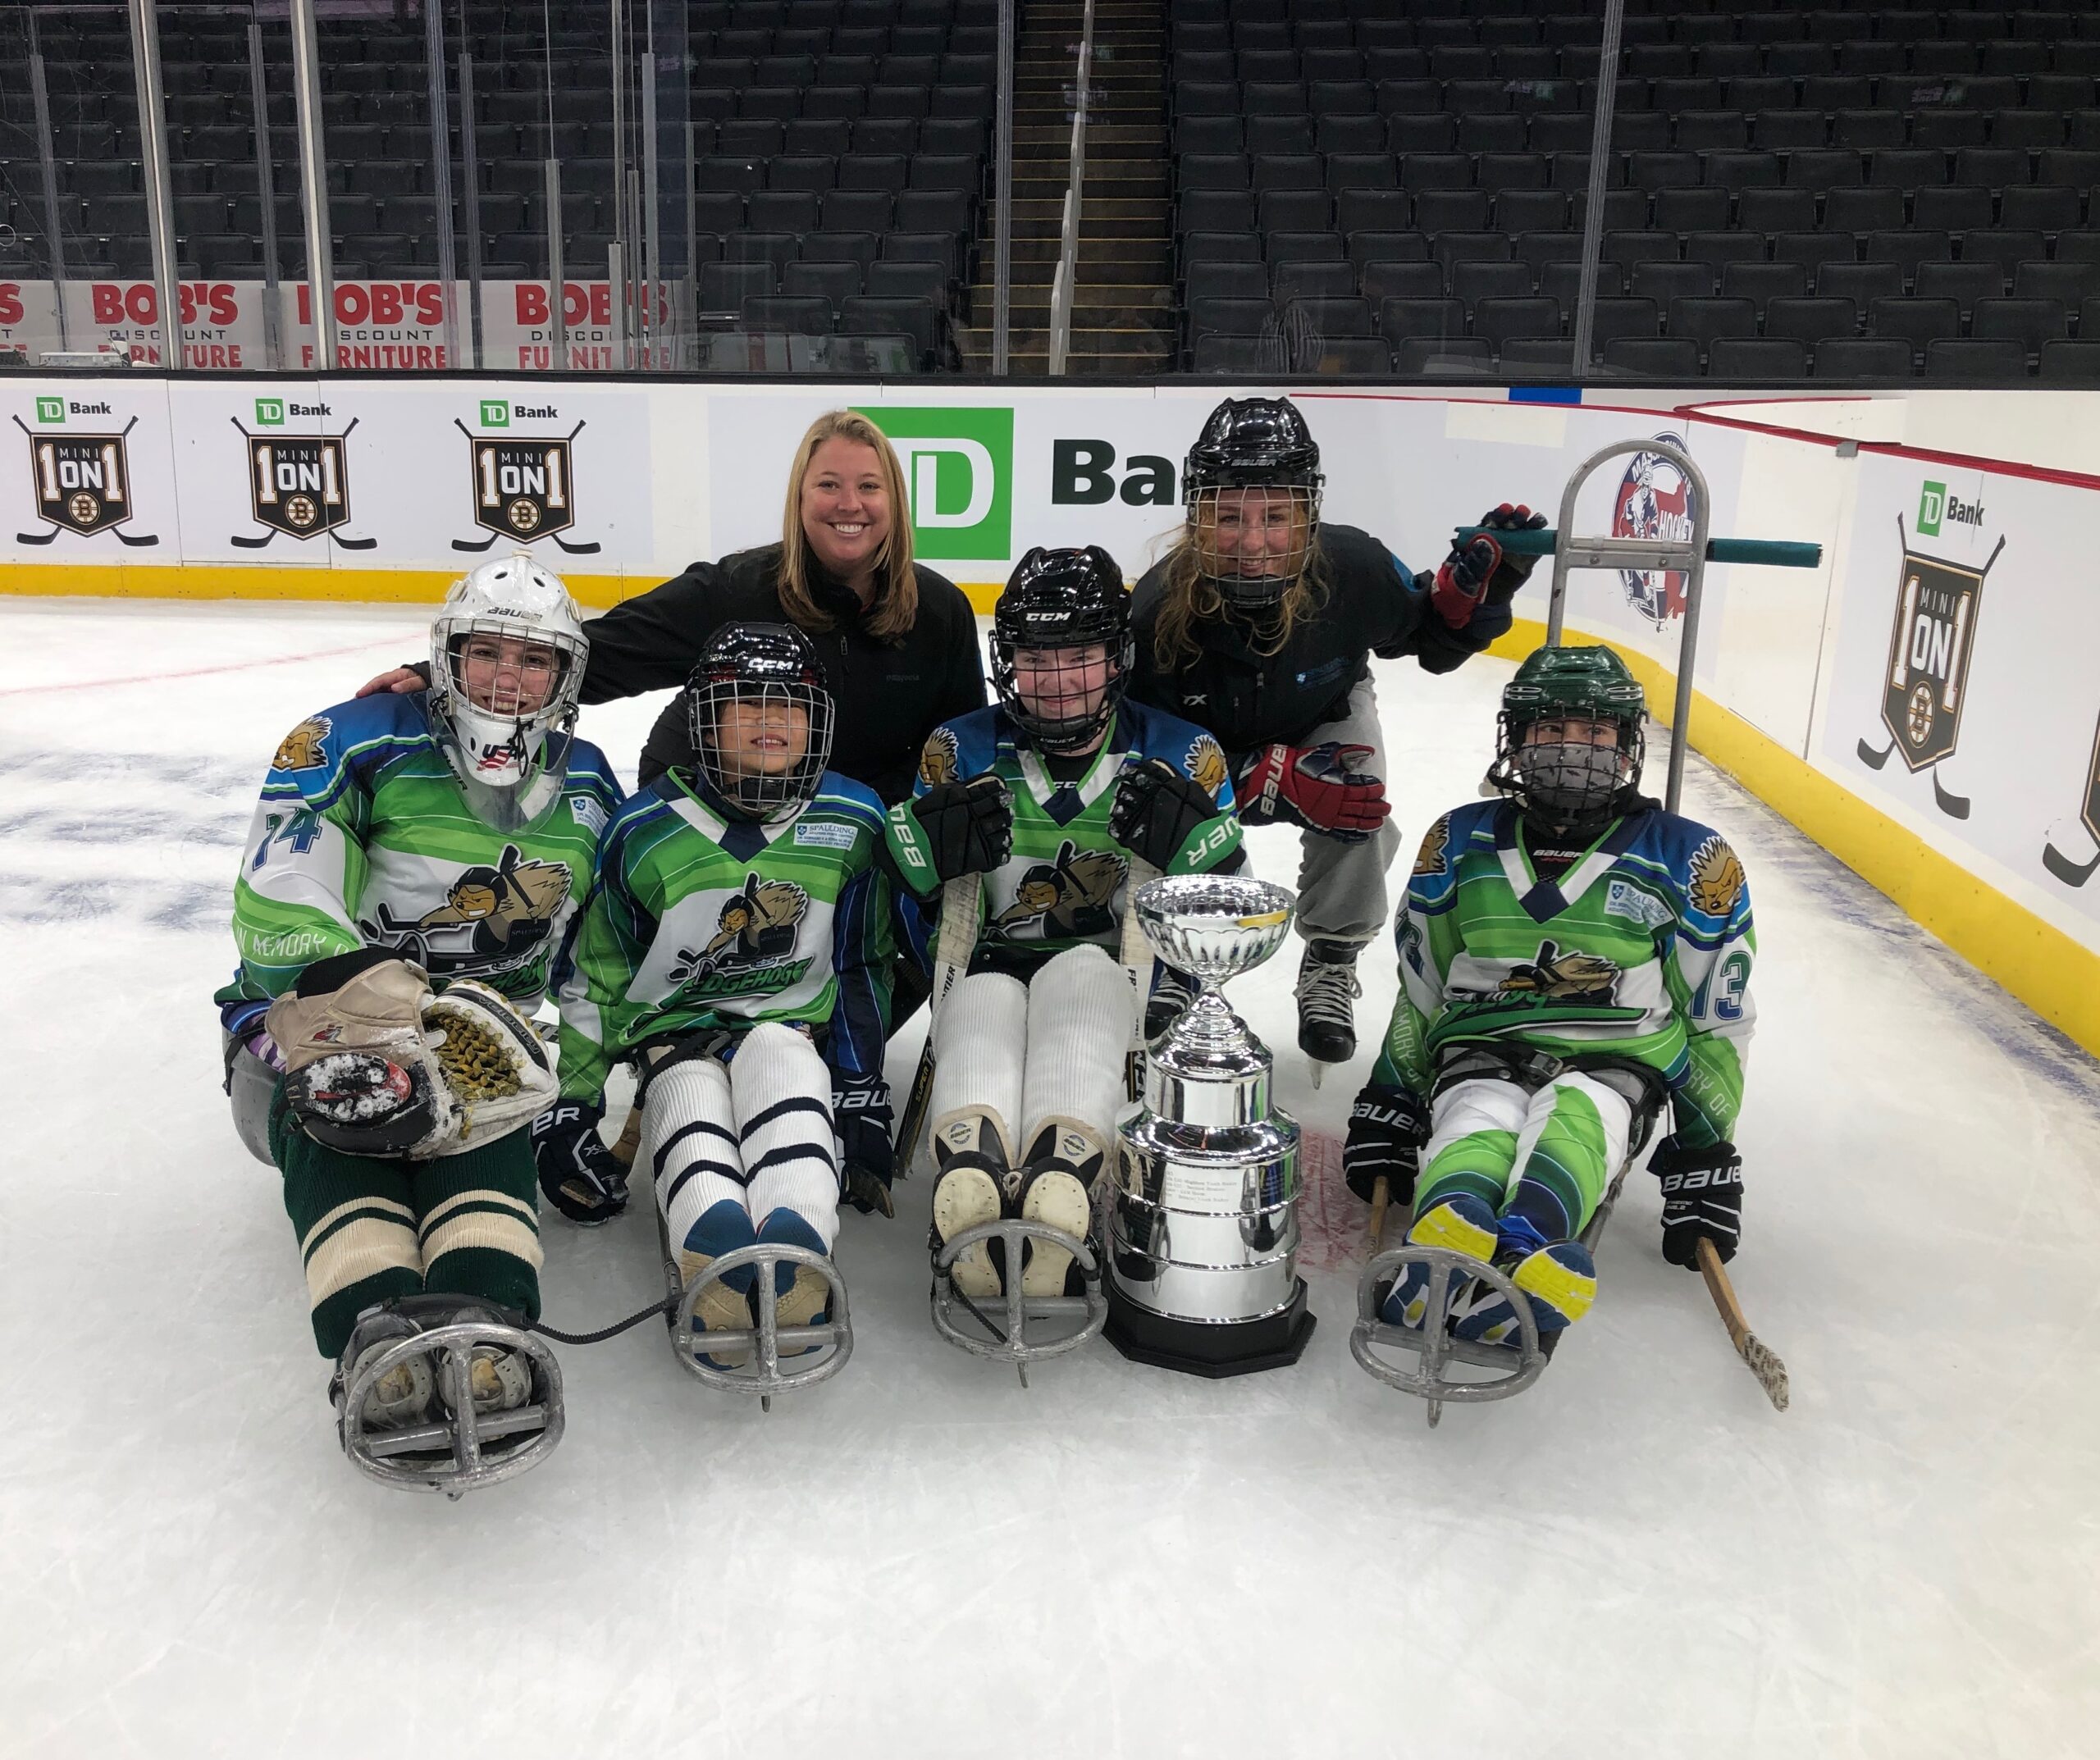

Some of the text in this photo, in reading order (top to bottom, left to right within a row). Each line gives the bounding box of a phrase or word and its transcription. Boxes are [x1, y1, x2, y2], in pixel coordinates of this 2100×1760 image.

[110, 330, 226, 340] DISCUNT
[341, 331, 433, 340] SCOUNT
[302, 345, 447, 369] FRNITURE
[38, 399, 112, 421] TD Bank
[257, 400, 332, 423] TD Bank
[482, 402, 559, 425] TD Bank
[59, 448, 99, 459] MINI
[277, 449, 317, 461] MINI
[501, 453, 542, 463] MINI
[60, 461, 103, 489] ON
[277, 463, 321, 491] ON
[500, 466, 545, 495] ON
[1051, 439, 1189, 505] Ba
[1920, 484, 1984, 531] TD Bank
[1658, 509, 1695, 541] HOCKEY
[1920, 586, 1956, 618] MINI
[1025, 612, 1071, 621] CCM
[1911, 613, 1953, 680] ON
[748, 659, 794, 671] CCM
[253, 807, 326, 872] 74
[1709, 1092, 1732, 1116] OF
[1661, 1165, 1741, 1193] BAUE
